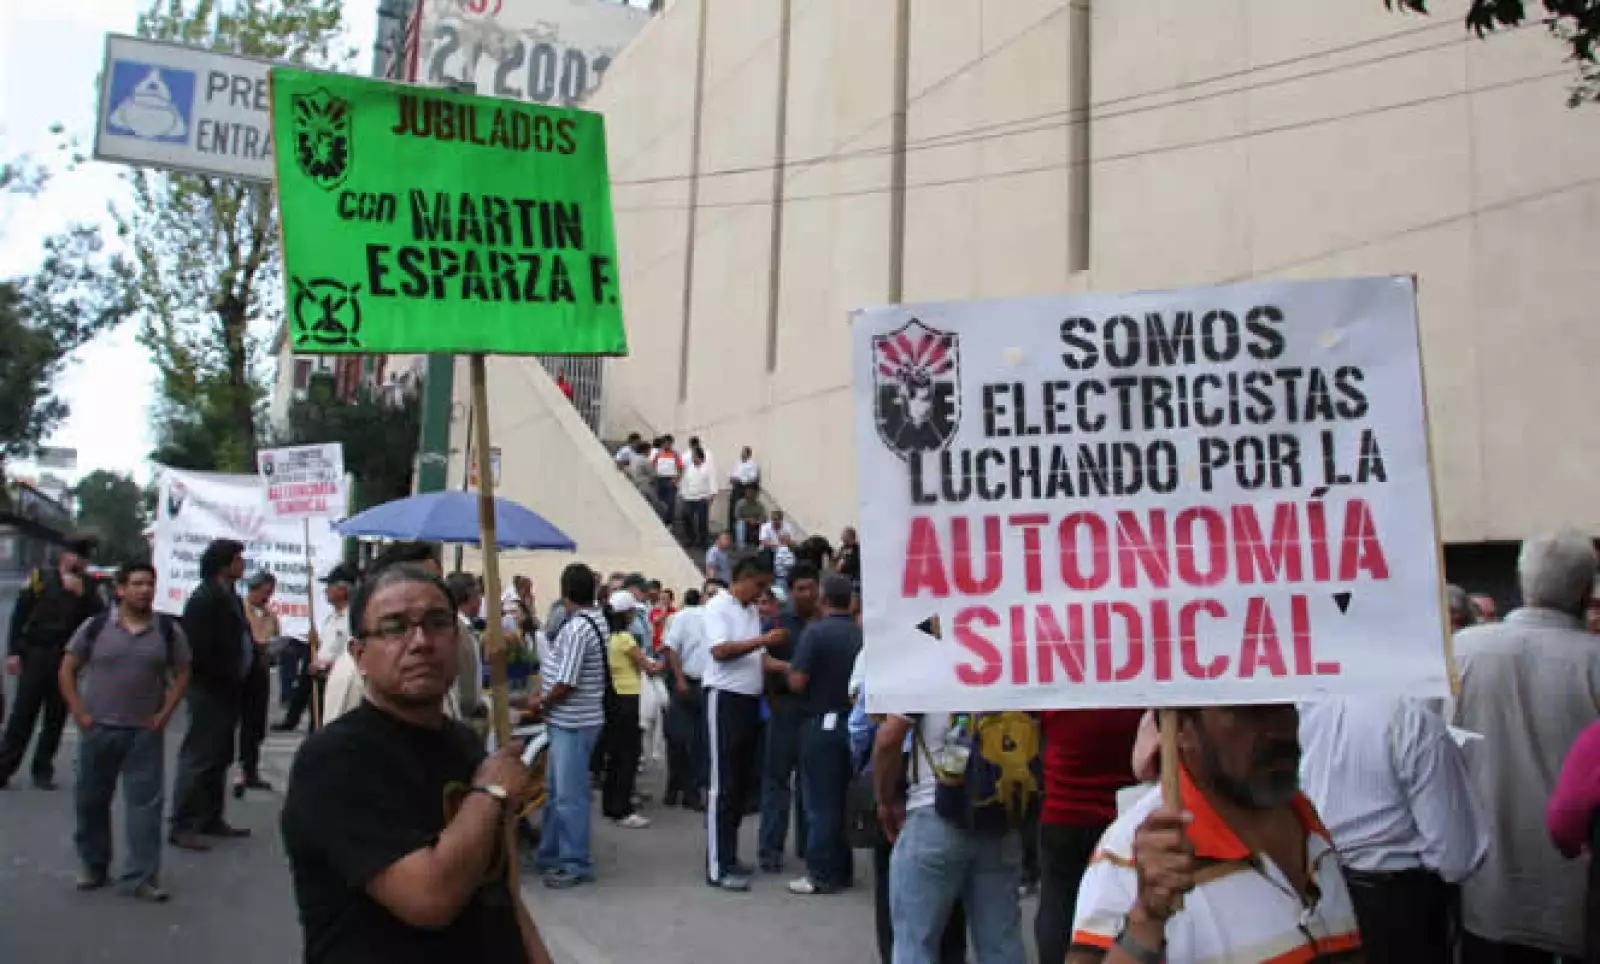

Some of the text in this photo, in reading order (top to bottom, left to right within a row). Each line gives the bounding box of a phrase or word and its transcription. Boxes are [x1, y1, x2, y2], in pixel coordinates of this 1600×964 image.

[392, 94, 577, 155] JUBILADOS
[410, 188, 584, 250] MARTIN
[366, 243, 618, 306] ESPARZA F.
[1060, 306, 1285, 370] SOMOS
[982, 365, 1368, 438] ELECTRICISTAS
[907, 427, 1387, 504] LUCHANDO POR LA
[902, 486, 1390, 597] AUTONOMÍA
[953, 593, 1341, 687] SINDICAL
